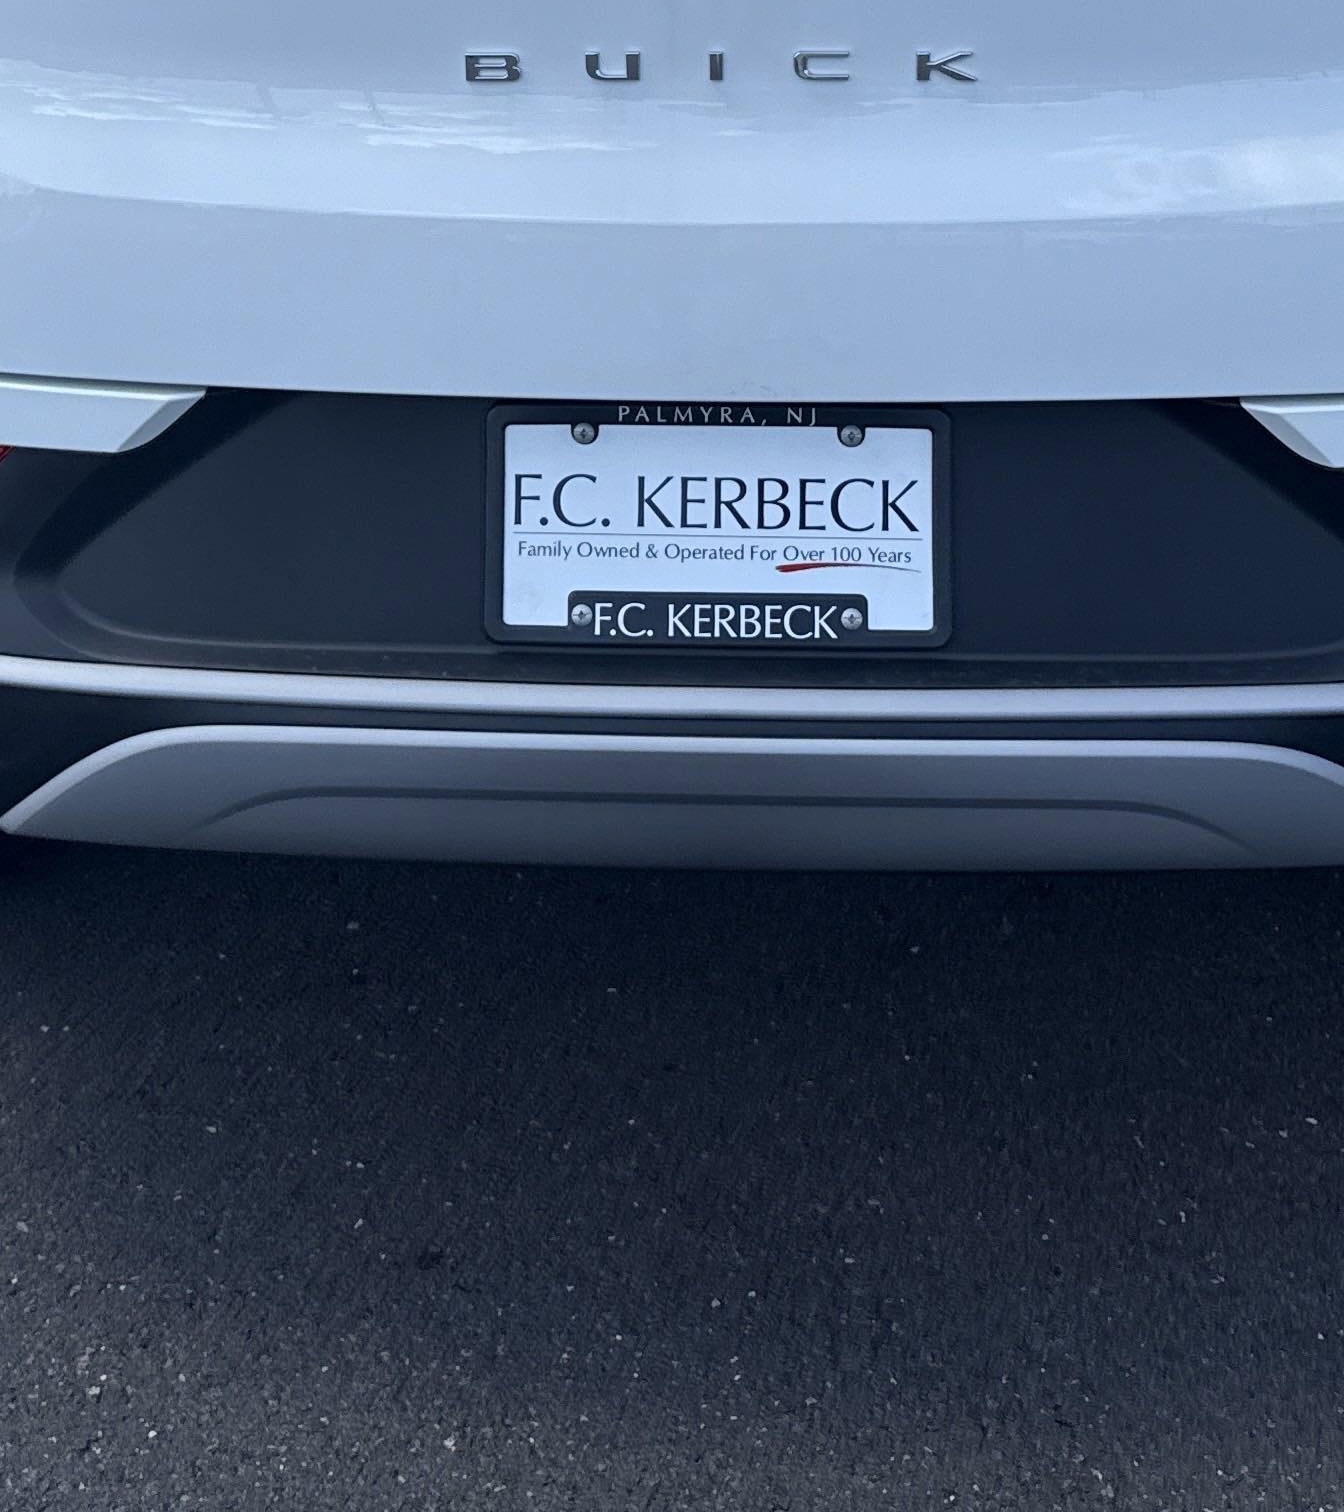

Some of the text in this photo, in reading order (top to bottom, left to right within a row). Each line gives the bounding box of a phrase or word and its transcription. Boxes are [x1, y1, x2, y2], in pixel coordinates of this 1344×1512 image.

[464, 50, 978, 81] BUICK
[618, 405, 816, 426] PALMYRA, NJ
[514, 473, 919, 532] F.C. KERBECK
[518, 540, 912, 563] Family Owned & Operated For Over 100 Years
[594, 602, 838, 639] F.C. KERBECK
